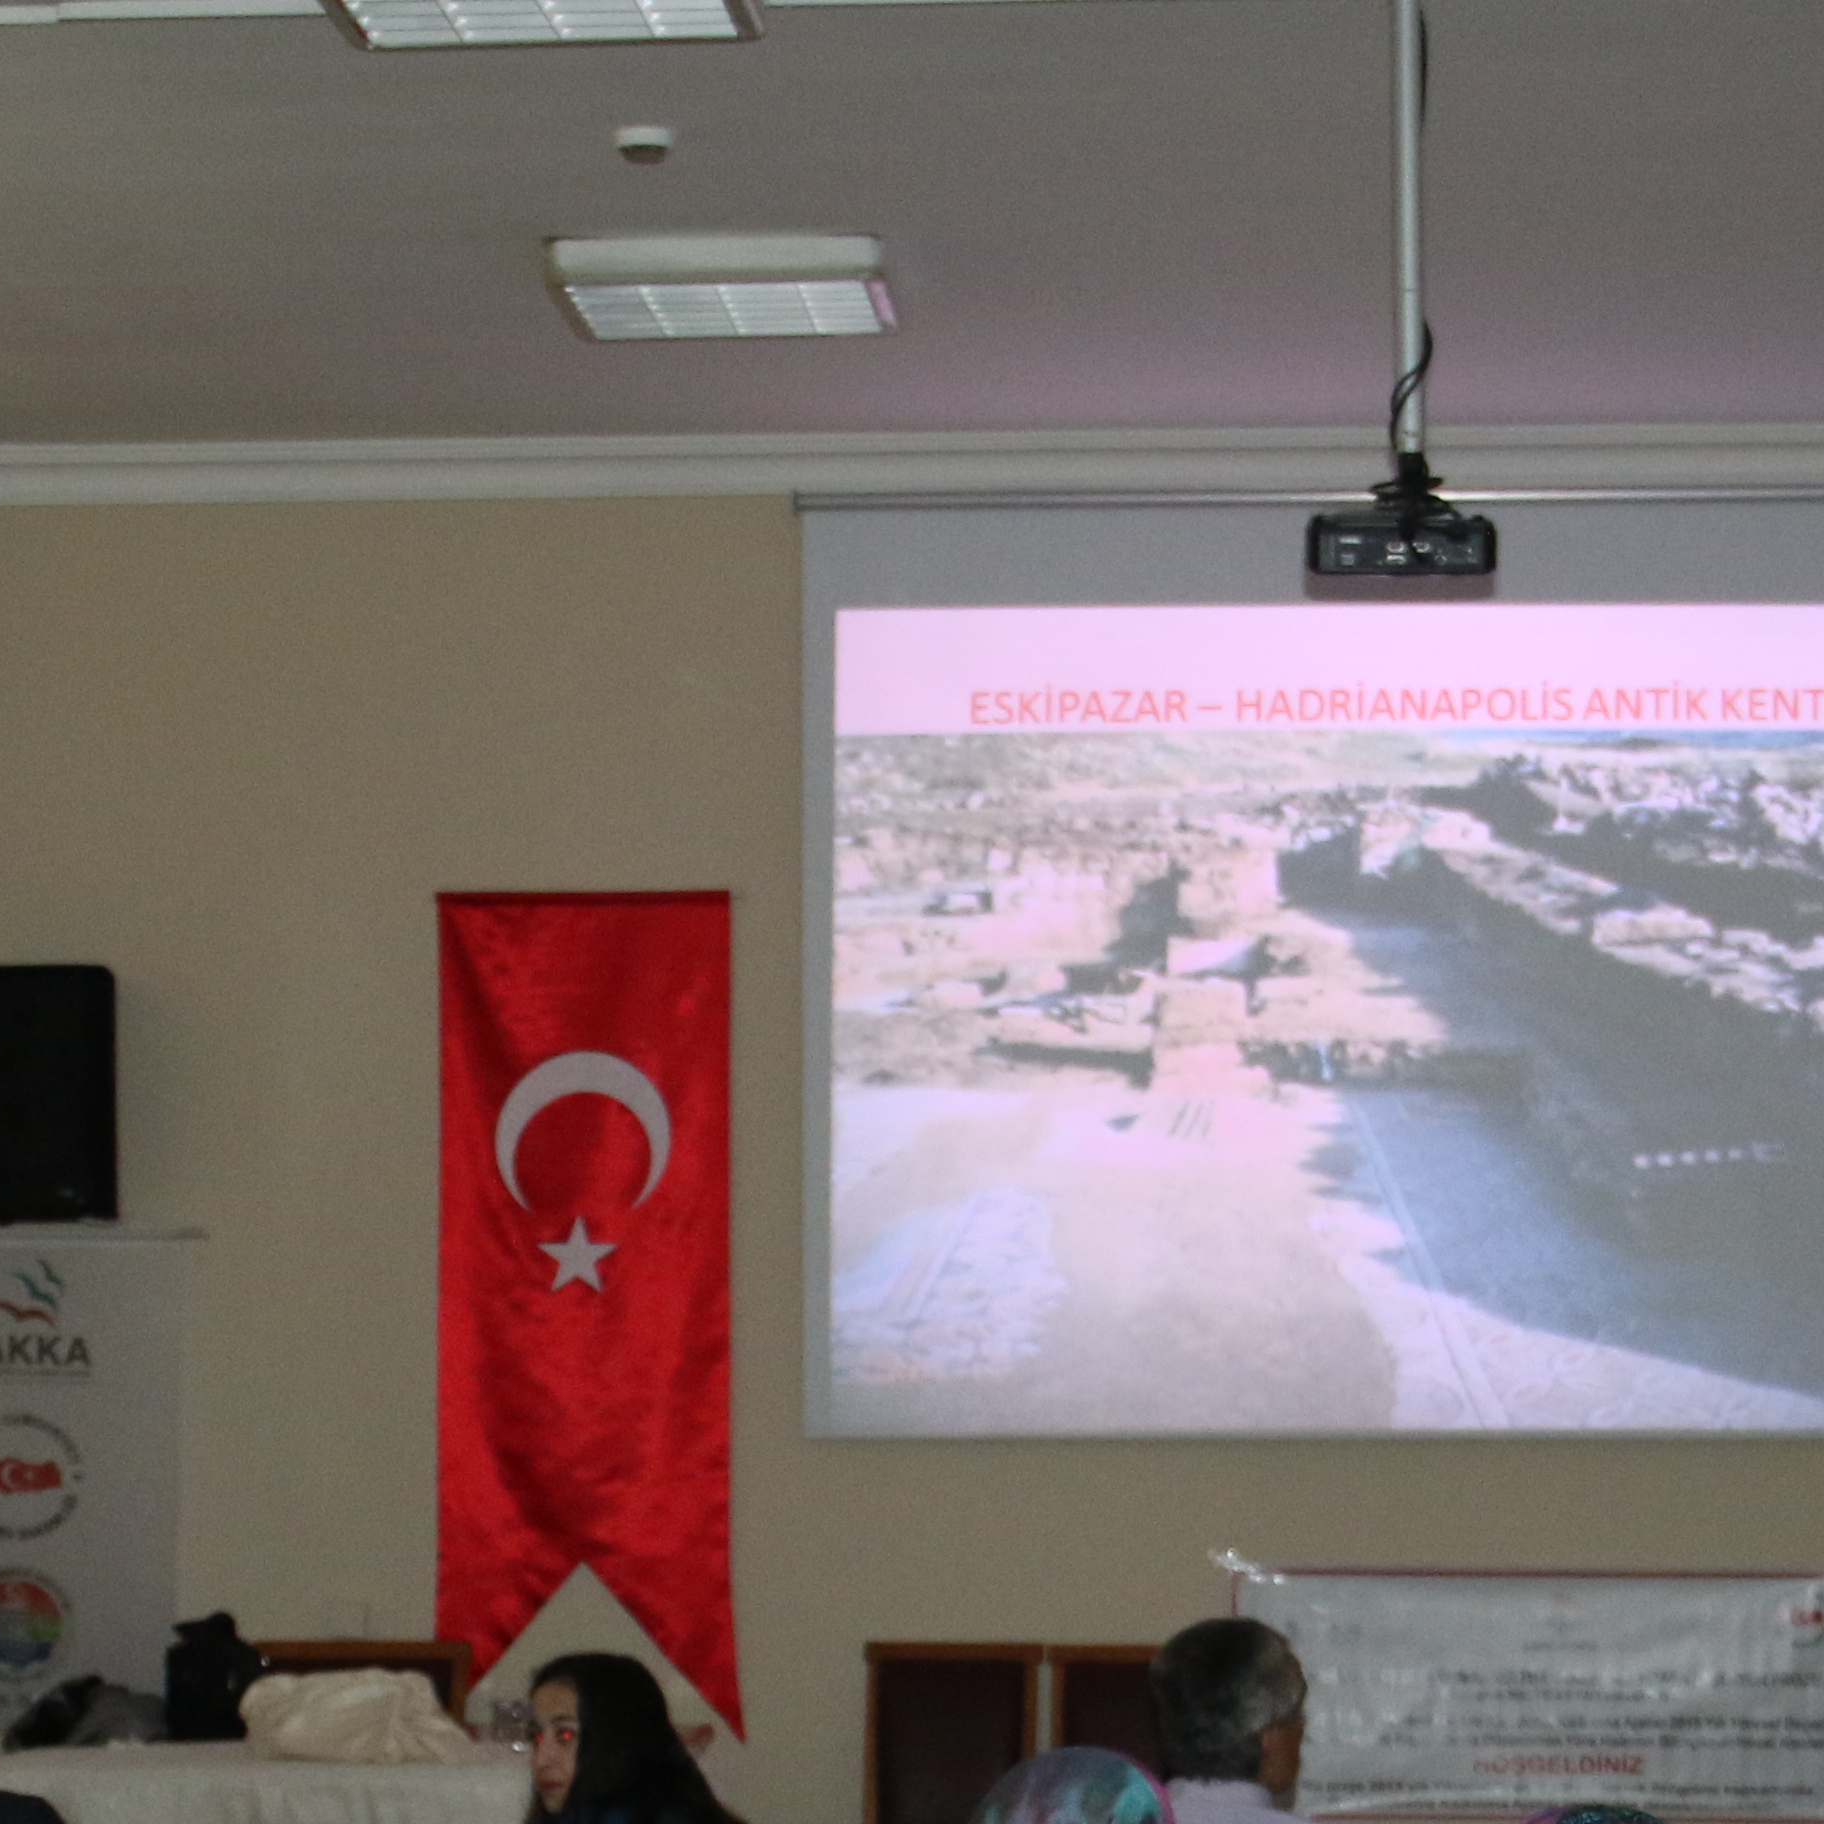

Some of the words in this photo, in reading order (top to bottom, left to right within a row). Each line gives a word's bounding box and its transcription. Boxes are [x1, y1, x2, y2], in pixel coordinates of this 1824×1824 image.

[969, 683, 1188, 724] ESKİPAZAR
[1236, 681, 1573, 723] HADRİANAPOLİS
[1582, 680, 1709, 722] ANTİK
